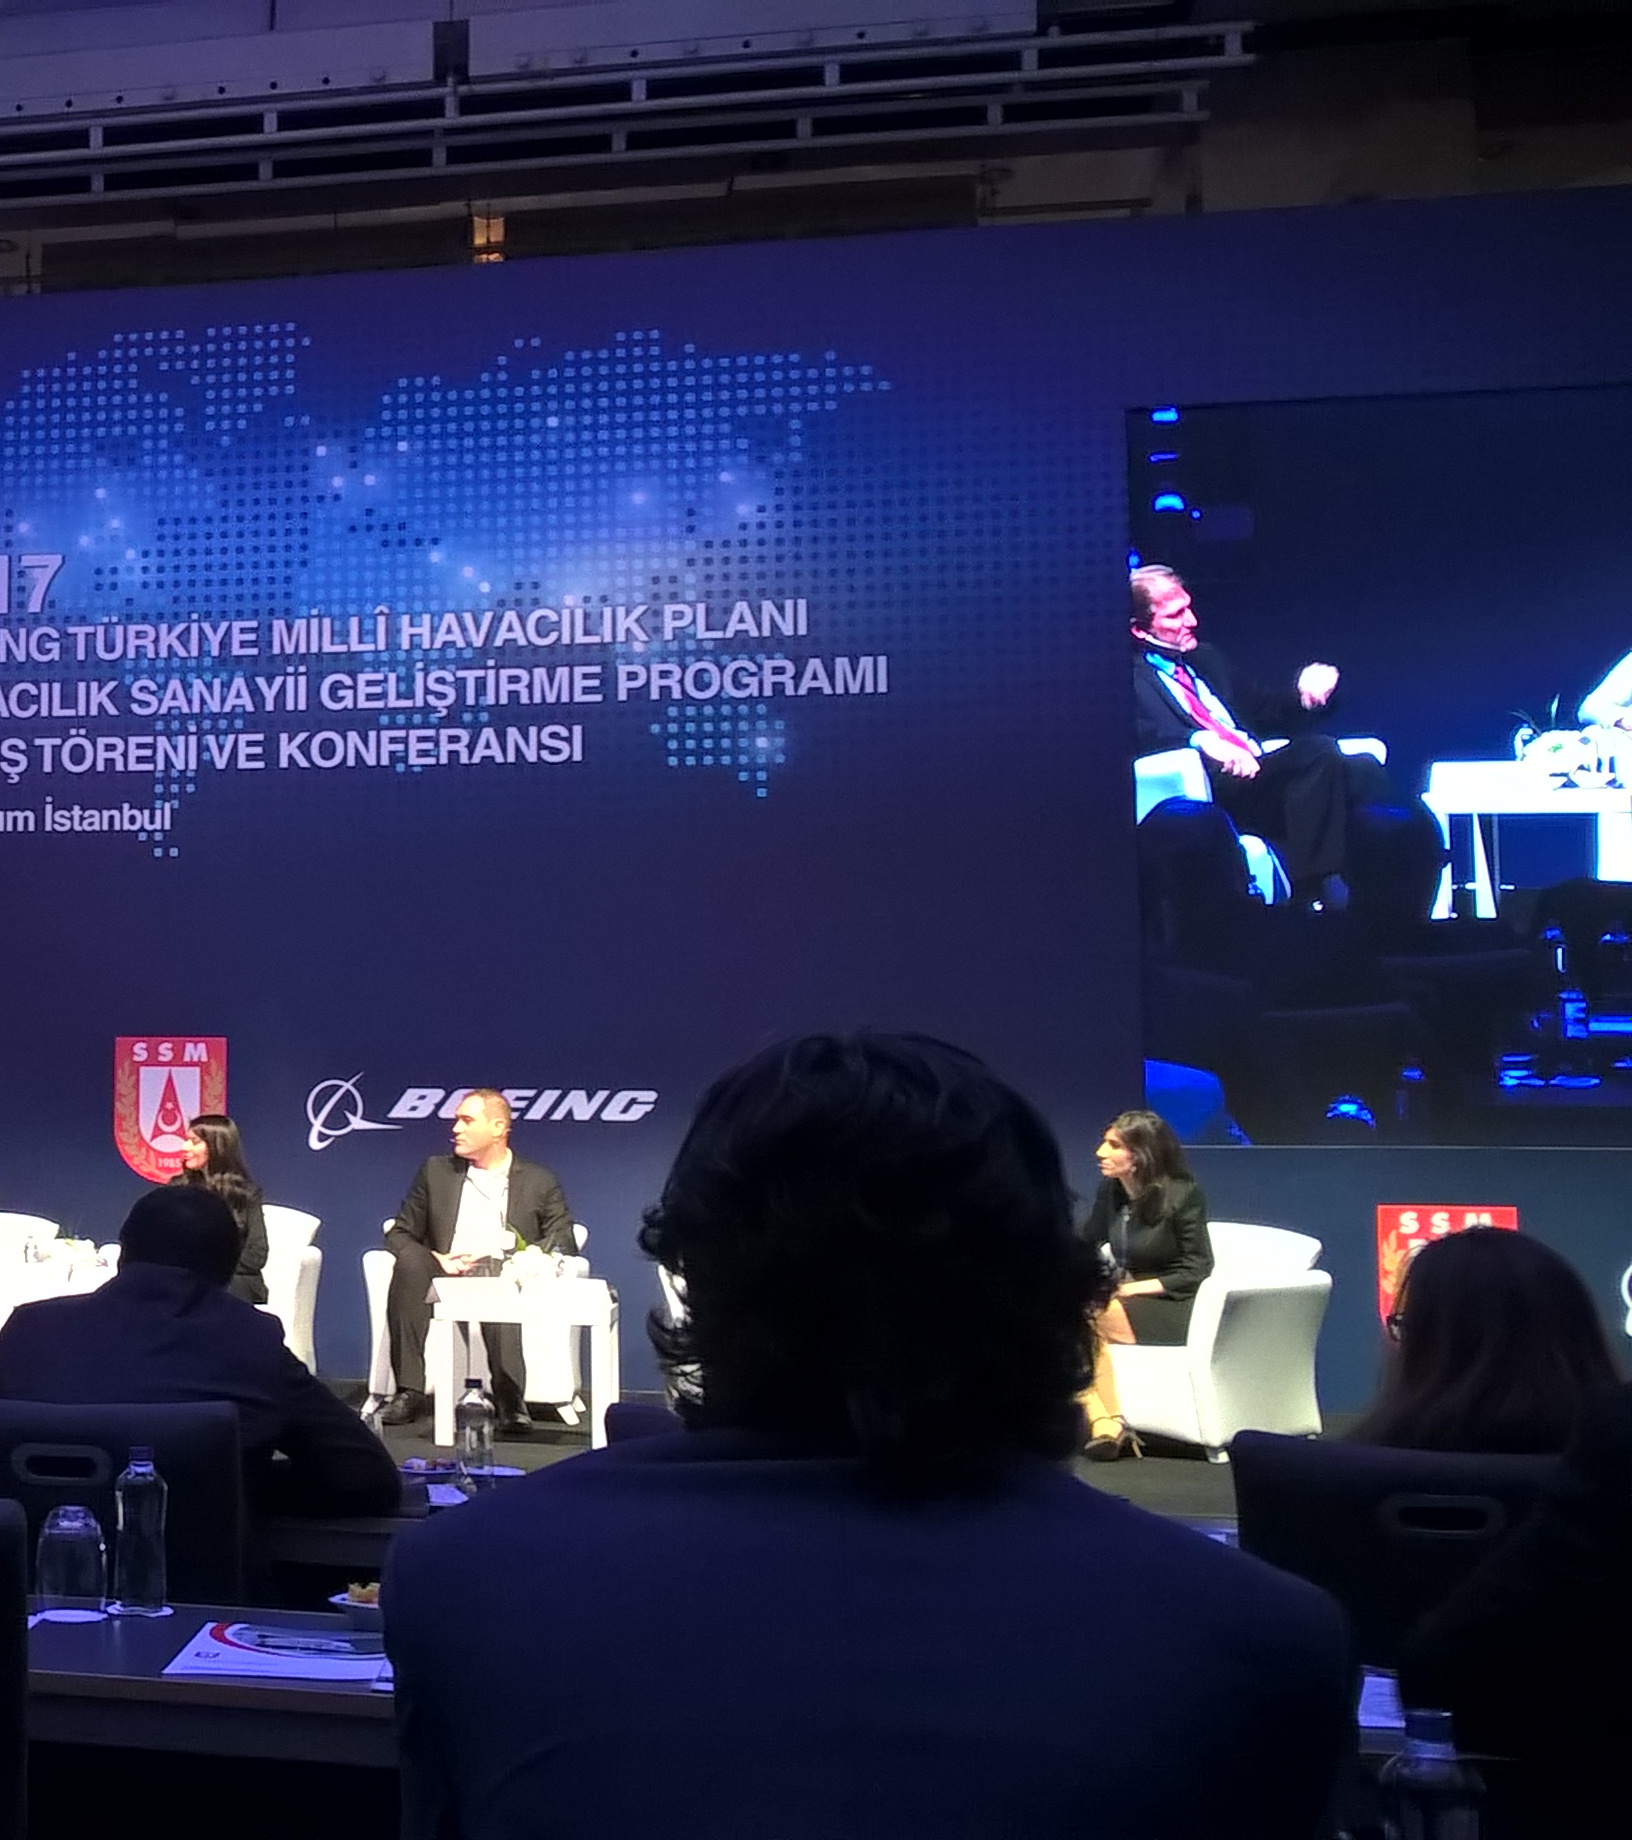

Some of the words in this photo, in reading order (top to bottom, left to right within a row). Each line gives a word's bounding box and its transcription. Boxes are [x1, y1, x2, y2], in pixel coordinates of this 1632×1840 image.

[68, 613, 259, 661] TÜRKİYE
[271, 605, 388, 654] MİLLÎ
[401, 604, 650, 650] HAVACILIK
[663, 599, 808, 640] PLANI
[129, 666, 307, 717] SANAYİİ
[320, 659, 603, 717] GELİŞTİRME
[617, 655, 888, 702] PROGRAMI
[34, 727, 198, 775] TÖRENİ
[206, 732, 266, 771] VE
[278, 723, 583, 769] KONFERANSI
[45, 796, 171, 832] İstanbul
[132, 1041, 208, 1062] SSM
